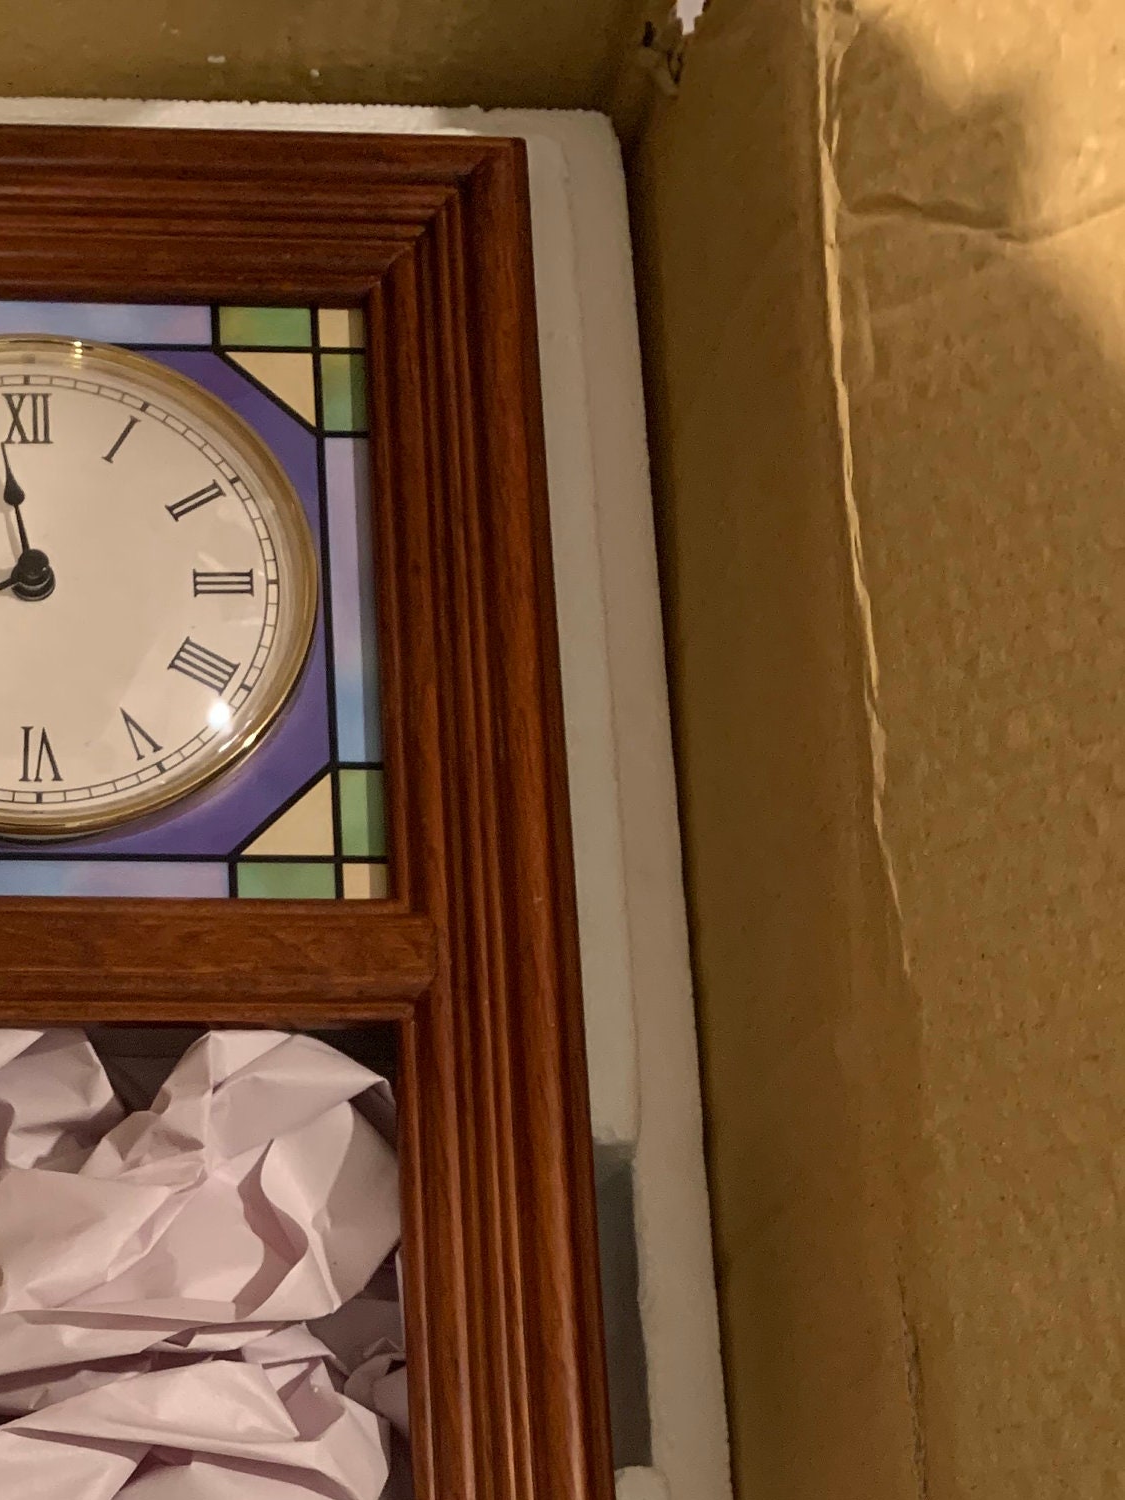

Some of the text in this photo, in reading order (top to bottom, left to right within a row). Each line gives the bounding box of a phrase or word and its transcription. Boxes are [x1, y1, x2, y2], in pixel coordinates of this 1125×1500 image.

[2, 393, 53, 445] XII
[102, 416, 142, 464] I
[165, 479, 226, 522] II
[193, 568, 254, 597] III
[167, 636, 241, 695] IIII
[19, 725, 63, 783] VI
[119, 706, 163, 761] V
